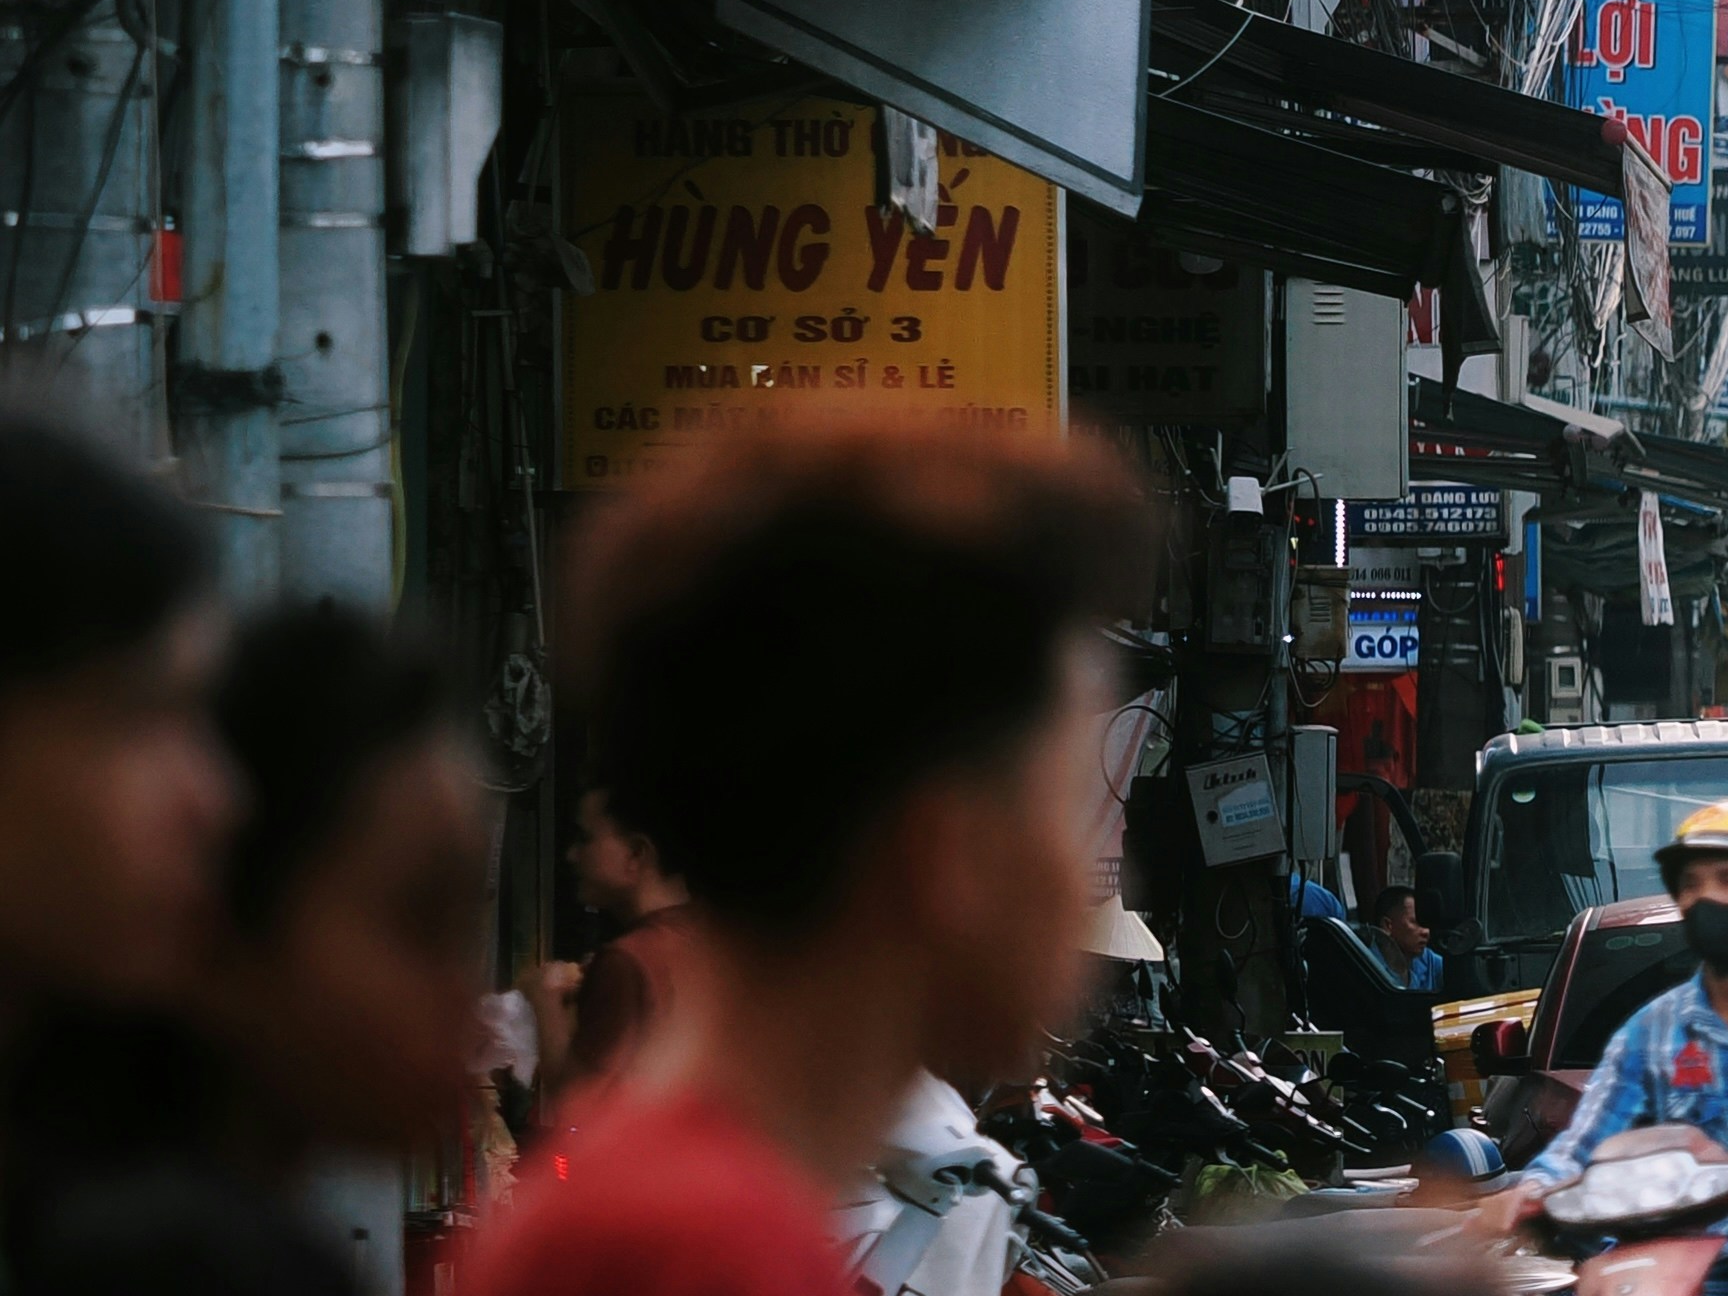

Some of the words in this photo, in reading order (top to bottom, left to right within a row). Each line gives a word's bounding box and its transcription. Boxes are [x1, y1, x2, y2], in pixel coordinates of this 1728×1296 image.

[775, 110, 855, 158] THỜ
[601, 179, 831, 292] HÙNG
[702, 315, 775, 342] CƠ
[794, 308, 871, 342] SỞ
[891, 316, 921, 342] 3
[665, 365, 740, 390] MUA
[1355, 626, 1419, 660] GÓP
